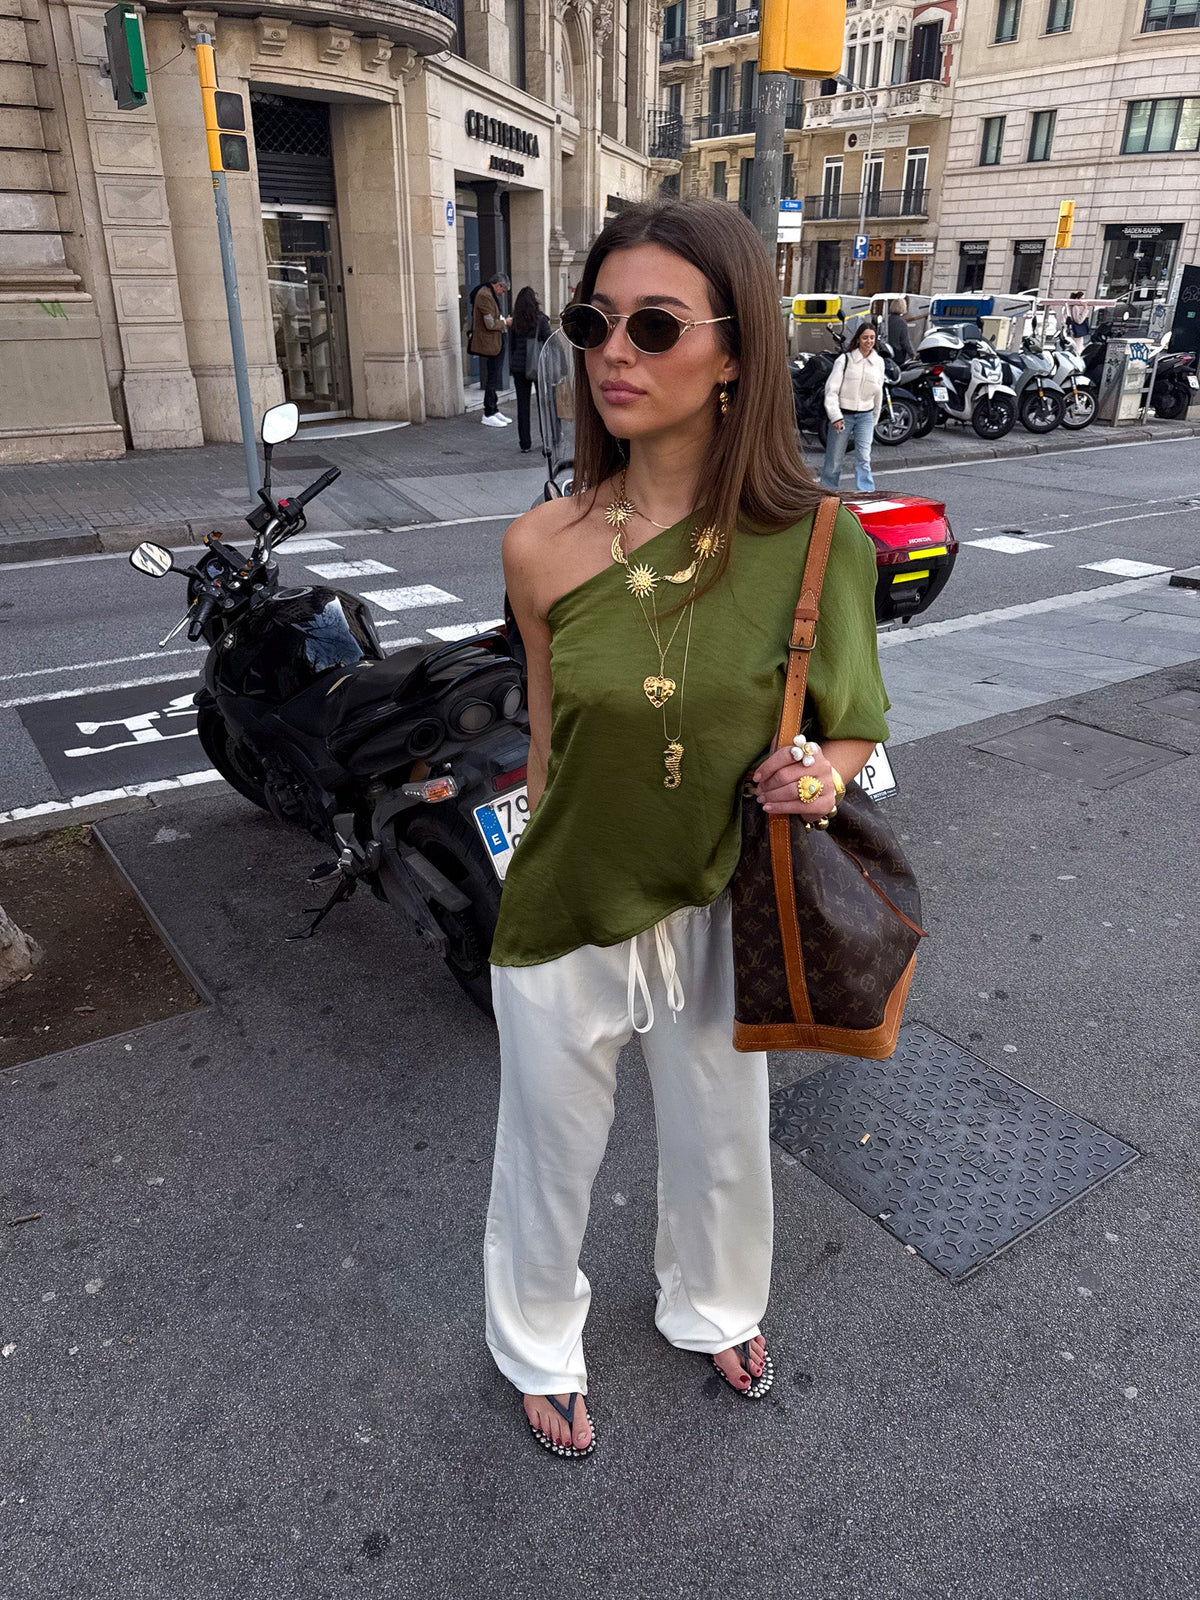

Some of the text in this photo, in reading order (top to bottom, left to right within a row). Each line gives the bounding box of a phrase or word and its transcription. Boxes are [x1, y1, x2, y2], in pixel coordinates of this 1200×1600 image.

[465, 109, 540, 158] CELTIBERICA
[856, 236, 867, 250] P
[491, 833, 502, 846] E
